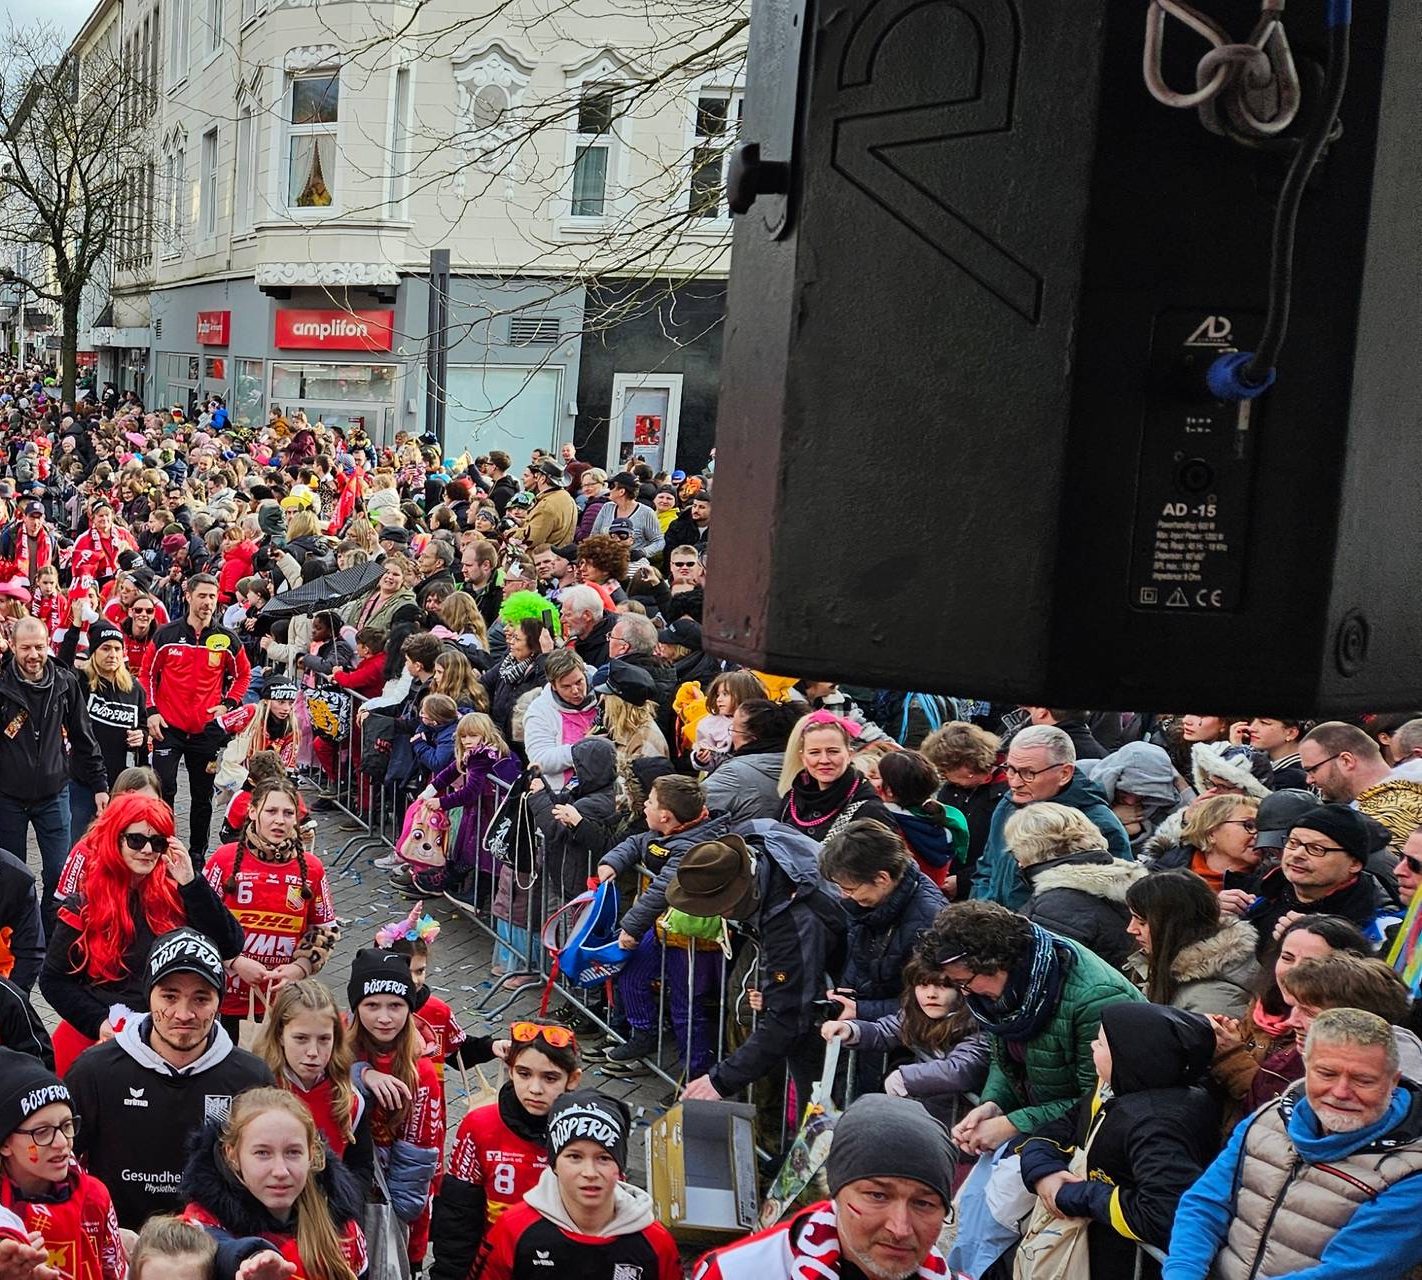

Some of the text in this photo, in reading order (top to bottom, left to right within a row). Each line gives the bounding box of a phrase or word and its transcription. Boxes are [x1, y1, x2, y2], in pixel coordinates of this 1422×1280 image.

[292, 318, 368, 341] amplifon
[1162, 503, 1218, 518] AD -15
[91, 702, 135, 722] BÖSPERDE
[237, 881, 254, 904] 6
[239, 912, 295, 930] DHL
[151, 940, 223, 976] BÖSPERDE
[364, 978, 408, 995] BÖSPERDE
[551, 1117, 620, 1153] BÖSPERDE
[121, 1169, 185, 1183] Gesundhei
[493, 1163, 516, 1195] 8
